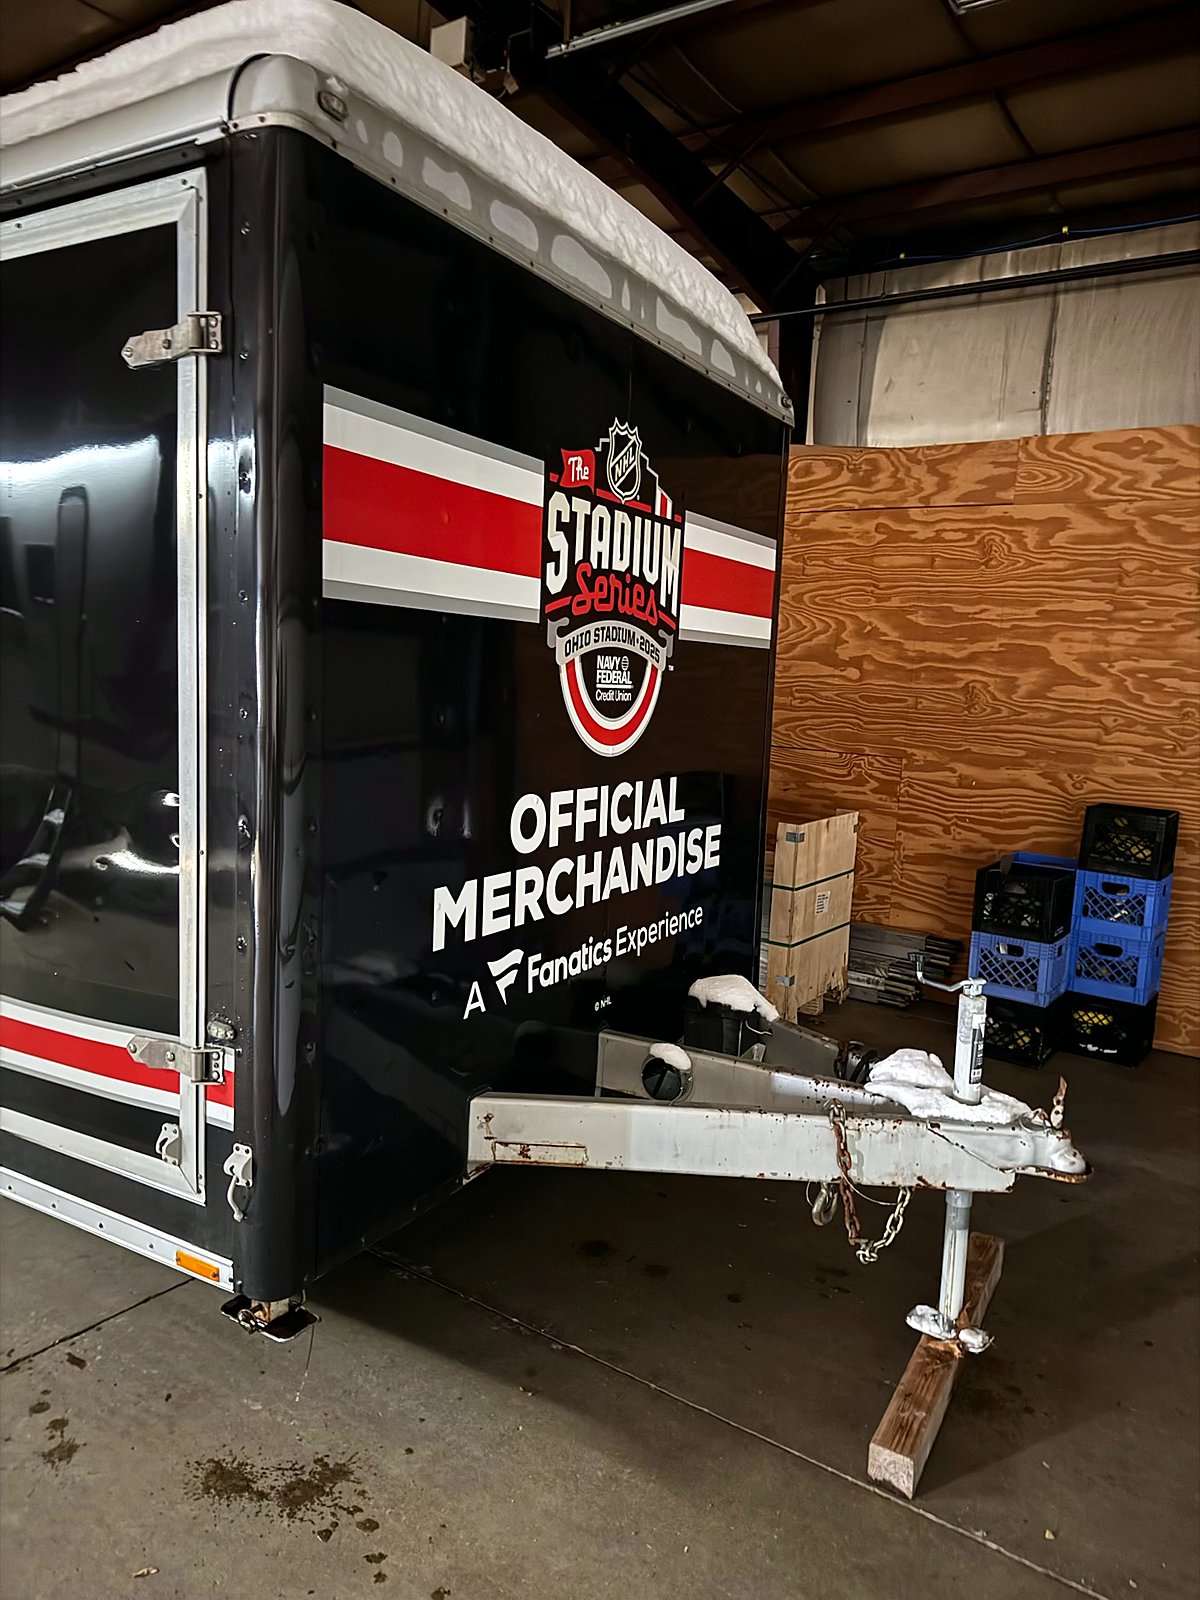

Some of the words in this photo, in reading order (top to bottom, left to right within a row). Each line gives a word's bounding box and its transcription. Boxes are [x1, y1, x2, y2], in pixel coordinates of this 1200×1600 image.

[568, 456, 589, 482] The
[614, 447, 635, 482] NHL
[546, 491, 682, 618] STADIUM
[571, 562, 658, 626] Series
[564, 629, 592, 657] OHIO
[594, 626, 636, 647] STADIUM
[639, 635, 661, 664] 2025
[596, 655, 621, 670] NAVY
[595, 688, 614, 702] Credit
[614, 689, 632, 702] Union
[596, 669, 633, 685] FEDERAL
[510, 776, 685, 854] OFFICIAL
[432, 823, 722, 952] MERCHANDISE
[463, 981, 487, 1020] A
[527, 936, 612, 994] Fanatics
[615, 906, 703, 957] Experience
